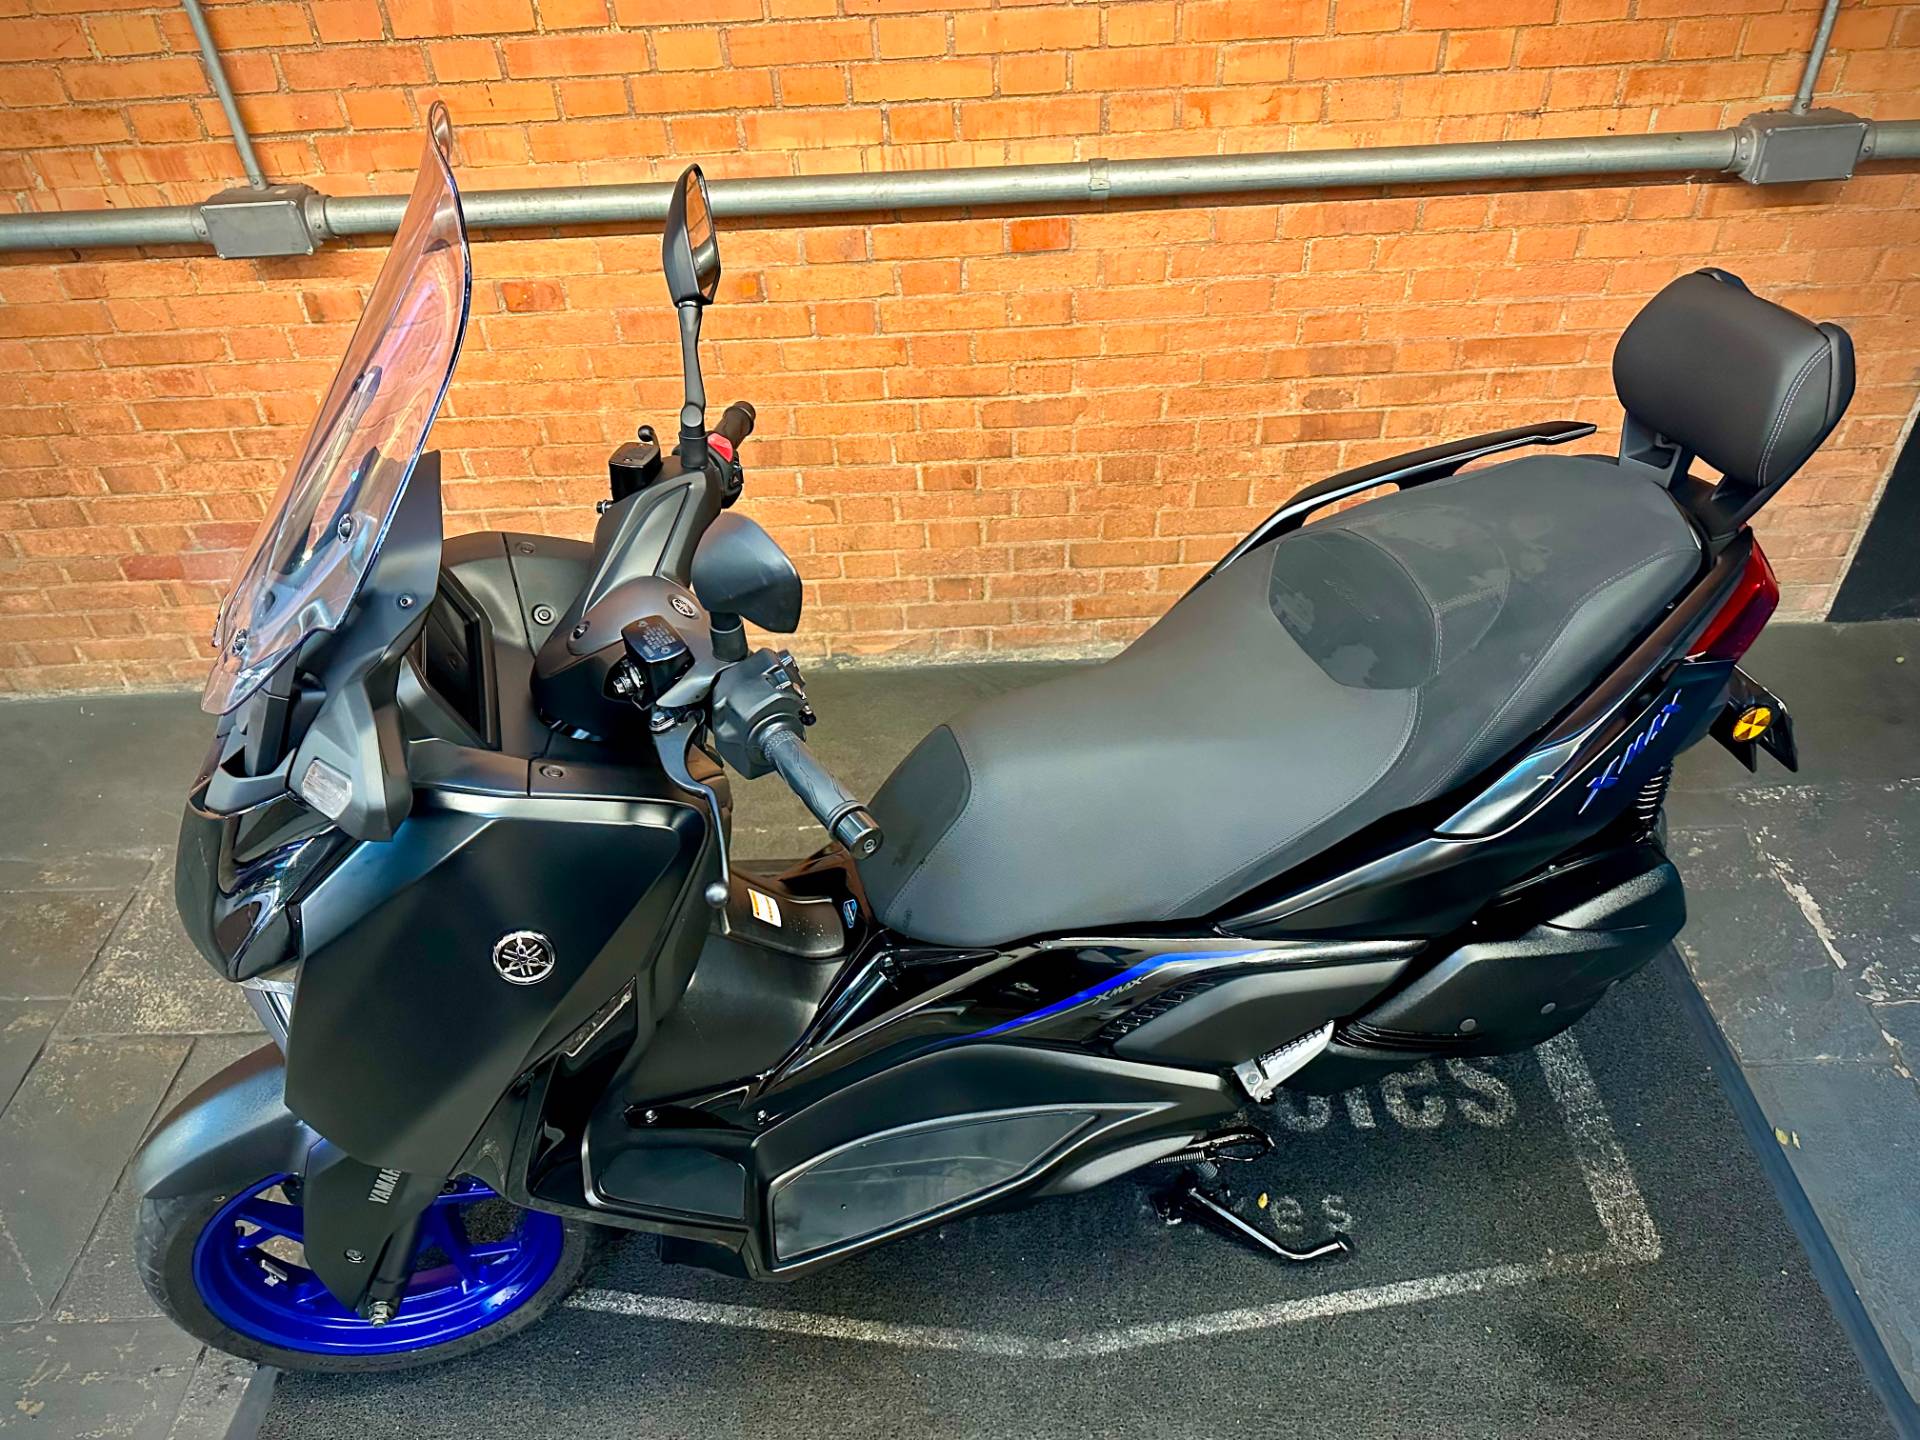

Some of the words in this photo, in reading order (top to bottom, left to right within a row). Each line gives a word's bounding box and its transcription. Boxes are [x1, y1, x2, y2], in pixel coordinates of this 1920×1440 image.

[1578, 688, 1682, 815] XMAX
[1092, 976, 1142, 1006] XMAX
[368, 1168, 402, 1204] YAMAH
